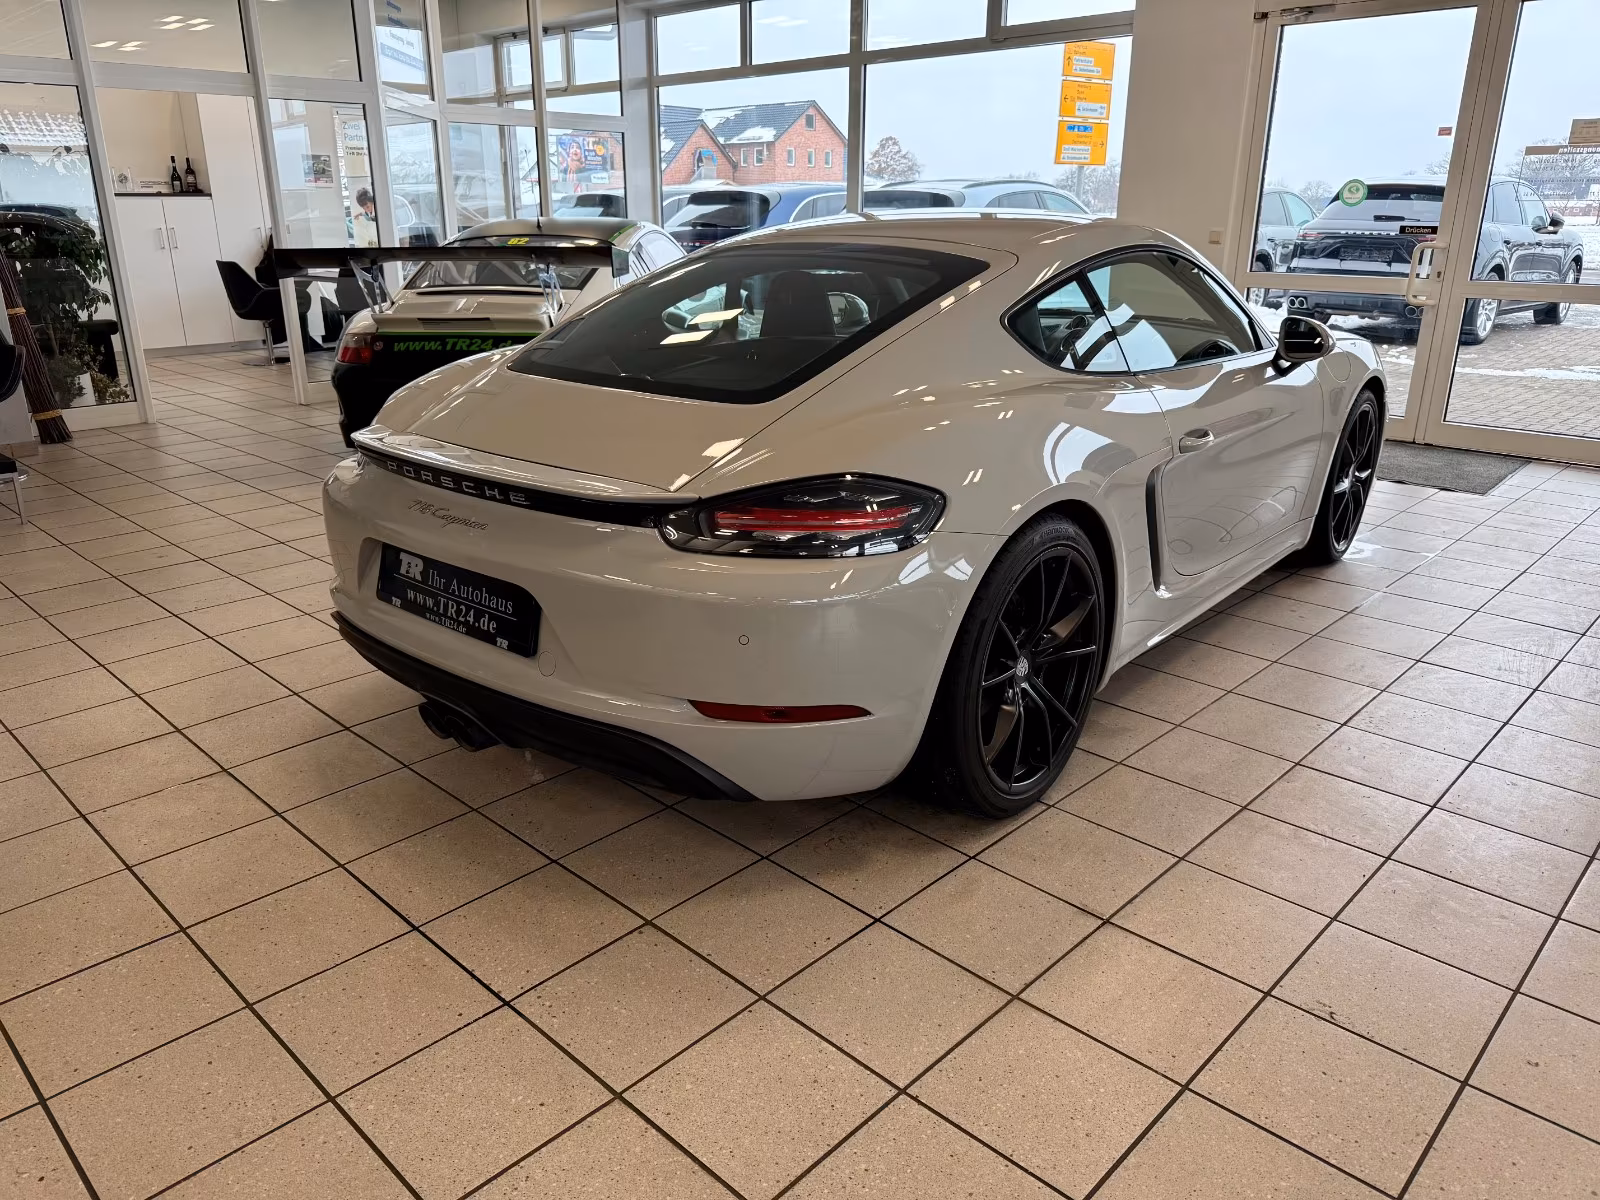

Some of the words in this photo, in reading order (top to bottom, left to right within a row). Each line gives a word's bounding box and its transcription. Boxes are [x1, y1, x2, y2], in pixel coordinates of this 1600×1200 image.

[342, 121, 361, 131] Zwei
[1405, 226, 1432, 234] Drücken
[387, 460, 530, 505] PORSCHE
[408, 498, 434, 515] 718
[432, 507, 489, 531] Cayman
[427, 568, 446, 589] Ihr
[449, 577, 514, 615] Autohaus
[406, 588, 497, 634] www.TR24.de
[425, 611, 467, 634] www.TR24.de
